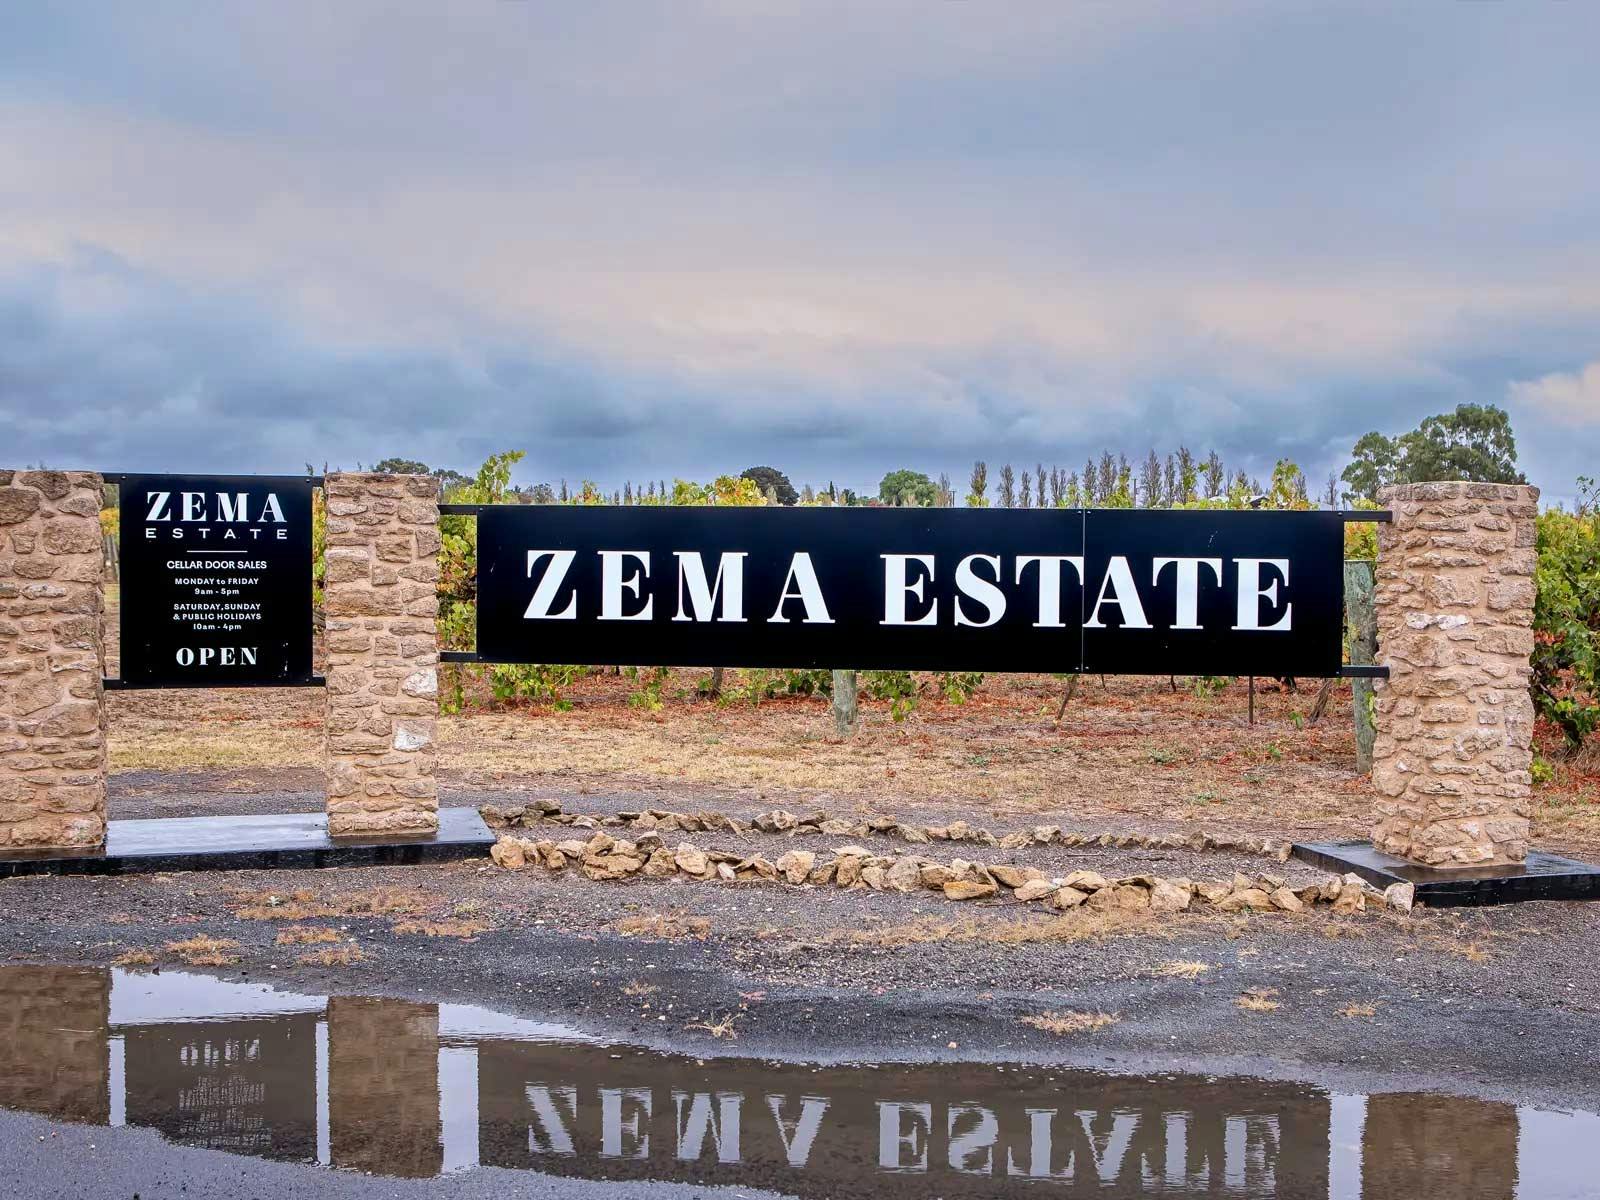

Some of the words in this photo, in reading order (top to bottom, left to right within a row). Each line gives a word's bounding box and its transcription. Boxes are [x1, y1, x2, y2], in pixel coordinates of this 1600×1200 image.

[145, 491, 288, 523] ZEMA
[145, 527, 288, 540] ESTATE
[166, 560, 203, 570] CELLAR
[204, 560, 236, 570] DOOR
[237, 560, 268, 570] SALES
[174, 577, 215, 585] MONDAY
[227, 577, 259, 585] FRIDAY
[194, 587, 214, 595] 9am
[220, 587, 240, 597] 5pm
[523, 548, 836, 624] ZEMA
[879, 552, 1293, 632] ESTATE
[224, 603, 262, 611] SUNDAY
[172, 613, 181, 621] &
[182, 613, 215, 621] PUBLIC
[216, 613, 262, 621] HOLIDAYS
[193, 623, 216, 631] 10am
[222, 623, 242, 632] 4pm
[175, 647, 258, 666] OPEN
